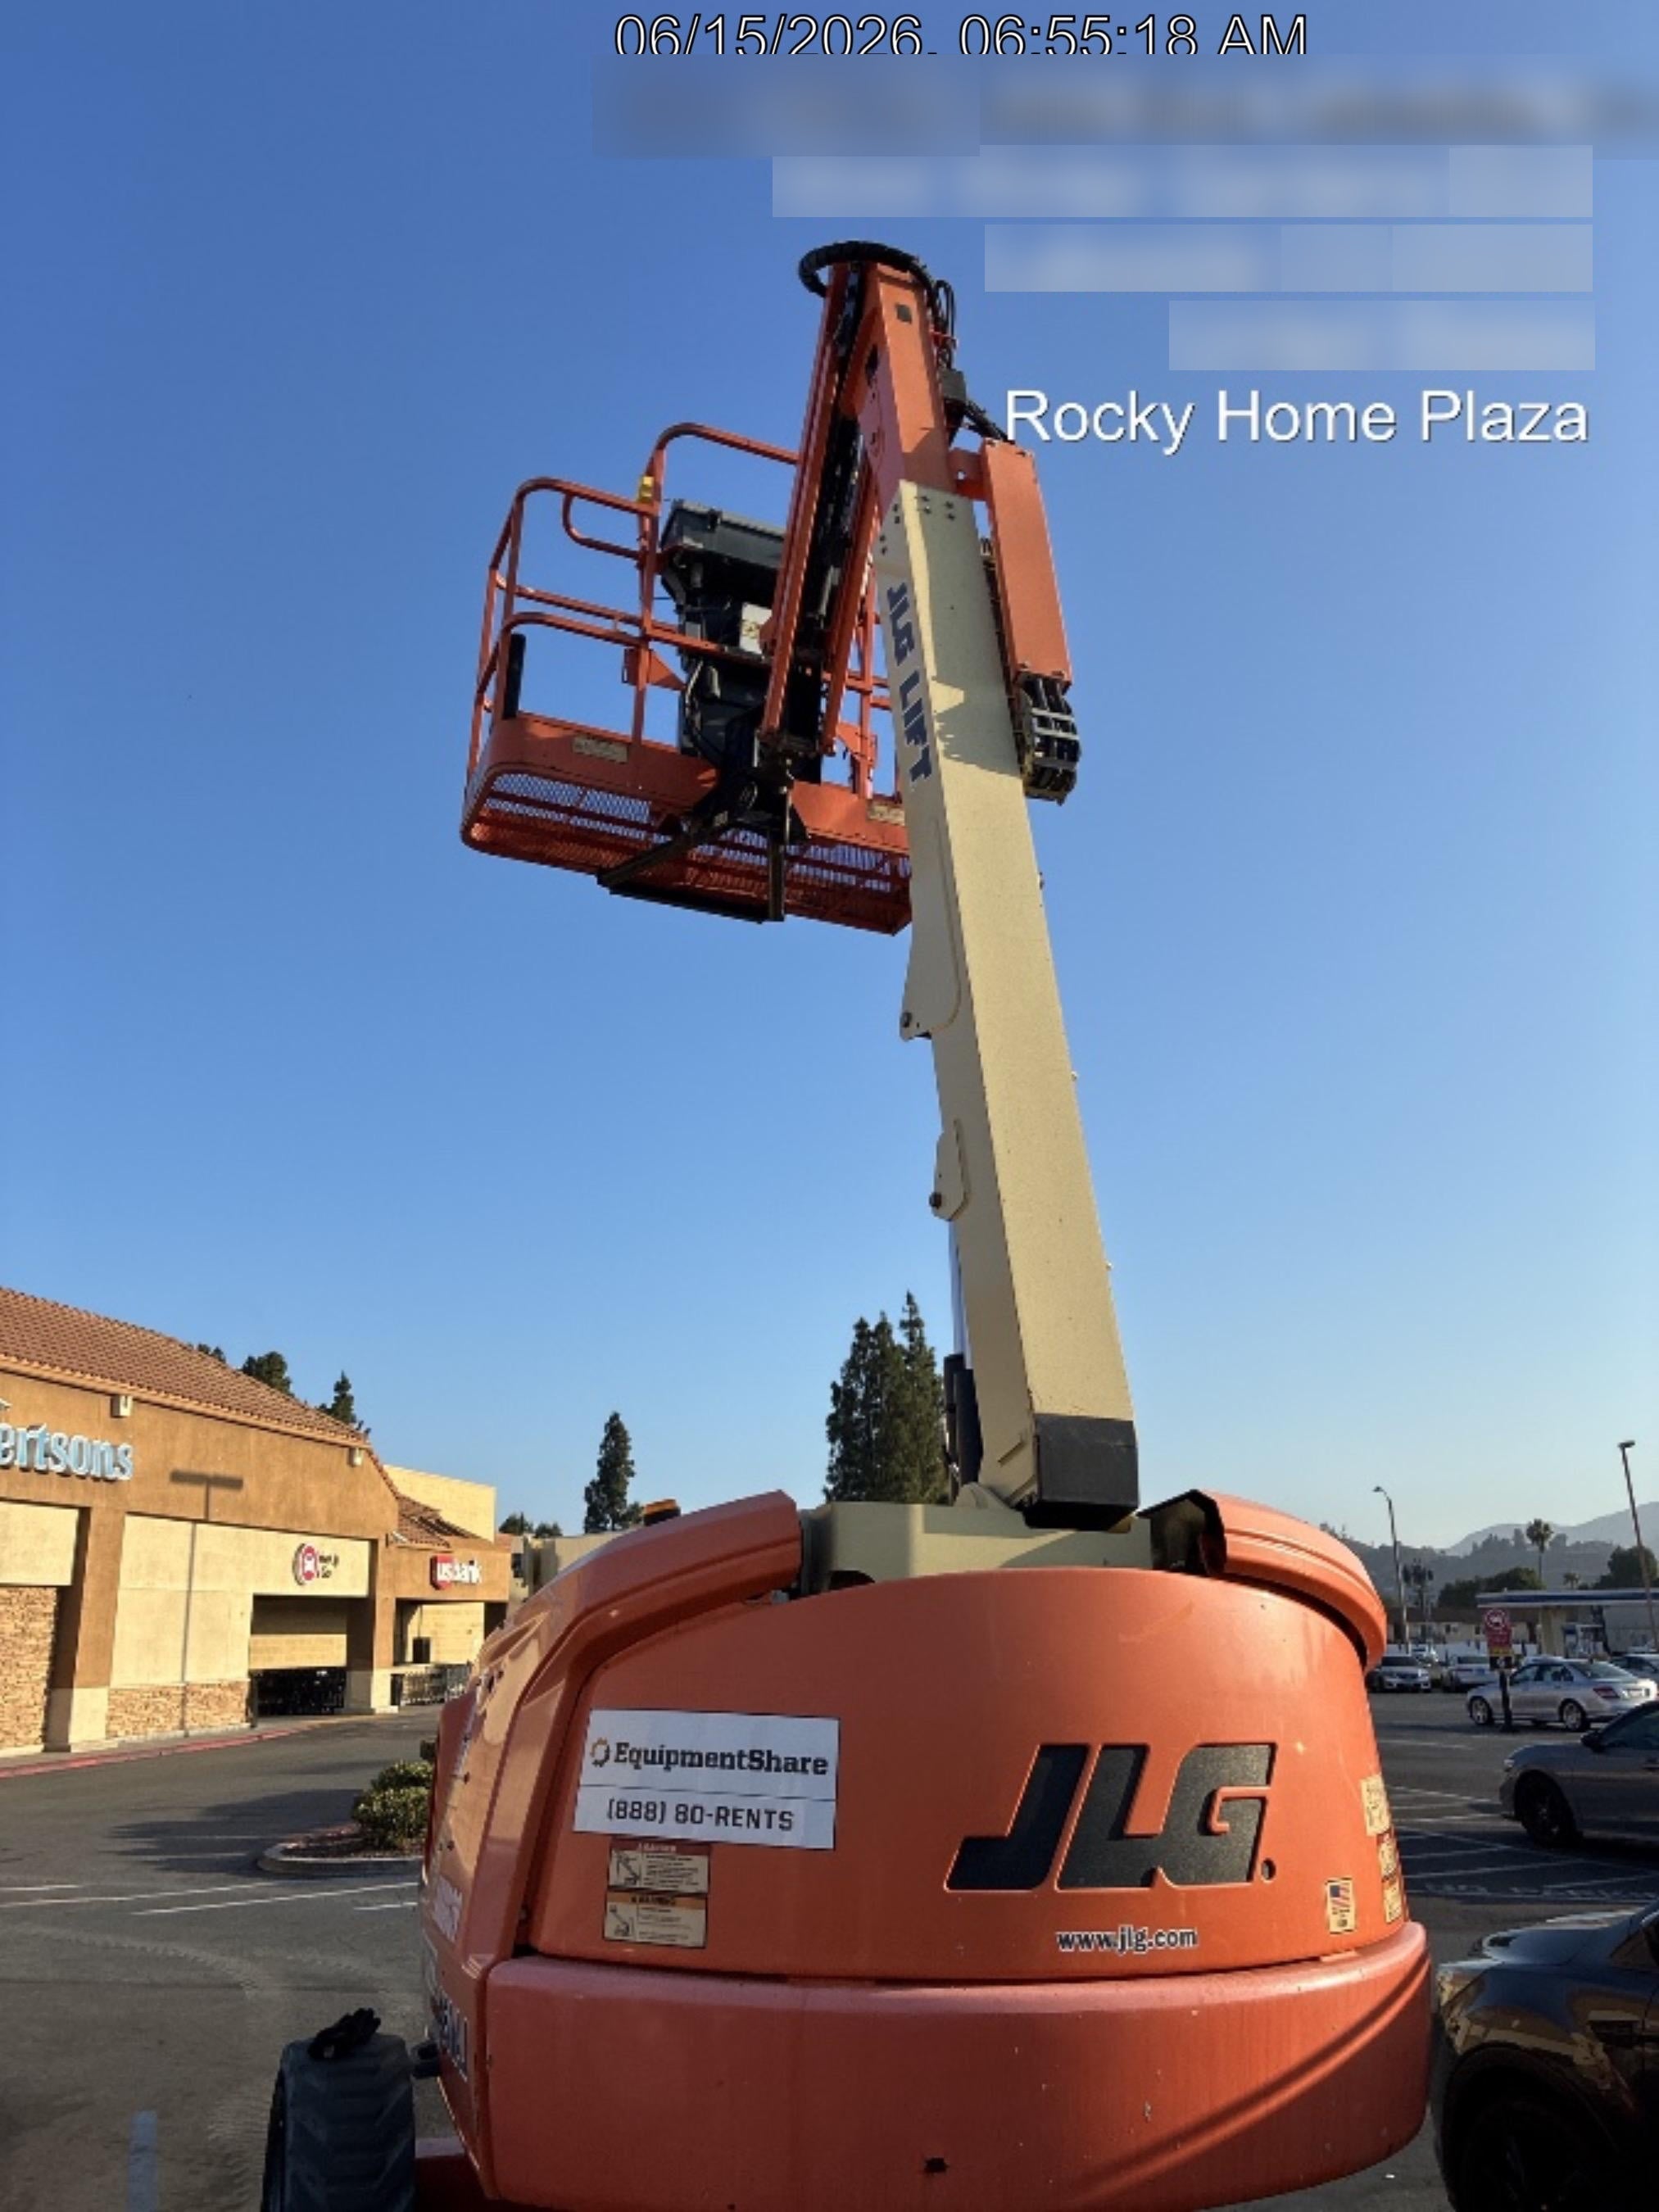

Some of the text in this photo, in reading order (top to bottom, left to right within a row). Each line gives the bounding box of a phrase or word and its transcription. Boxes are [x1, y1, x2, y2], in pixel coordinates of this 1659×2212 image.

[886, 582, 932, 782] JLG LIFT
[614, 1742, 829, 1776] EquipmentShare
[607, 1798, 795, 1832] (888) 80-RENTS
[1057, 1924, 1199, 1956] www.jlg.com
